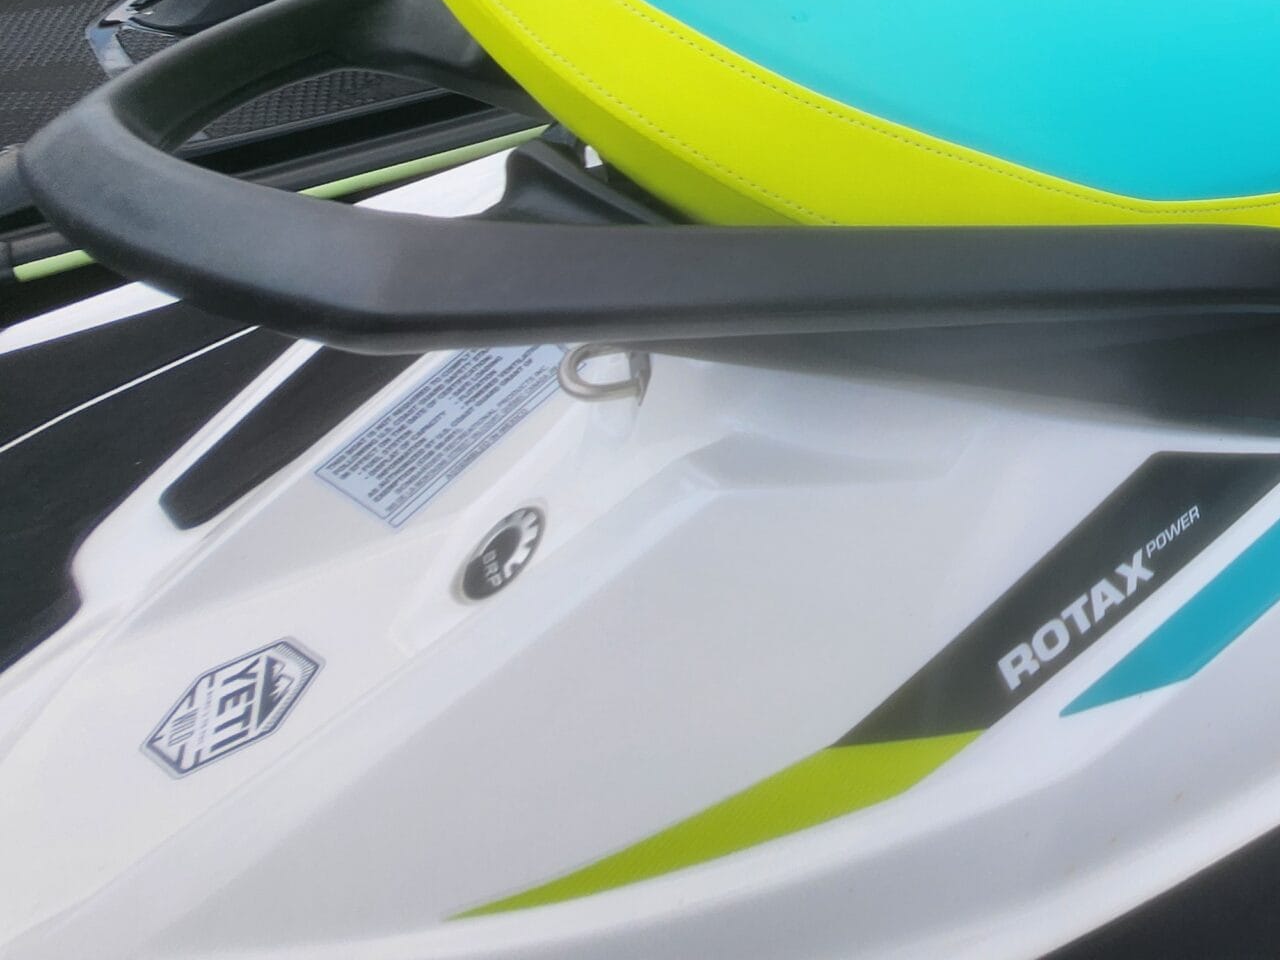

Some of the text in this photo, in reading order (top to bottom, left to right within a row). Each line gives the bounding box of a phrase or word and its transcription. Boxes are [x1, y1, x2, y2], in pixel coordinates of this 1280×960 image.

[998, 505, 1200, 691] ROTAX POWER
[210, 657, 261, 753] YETI
